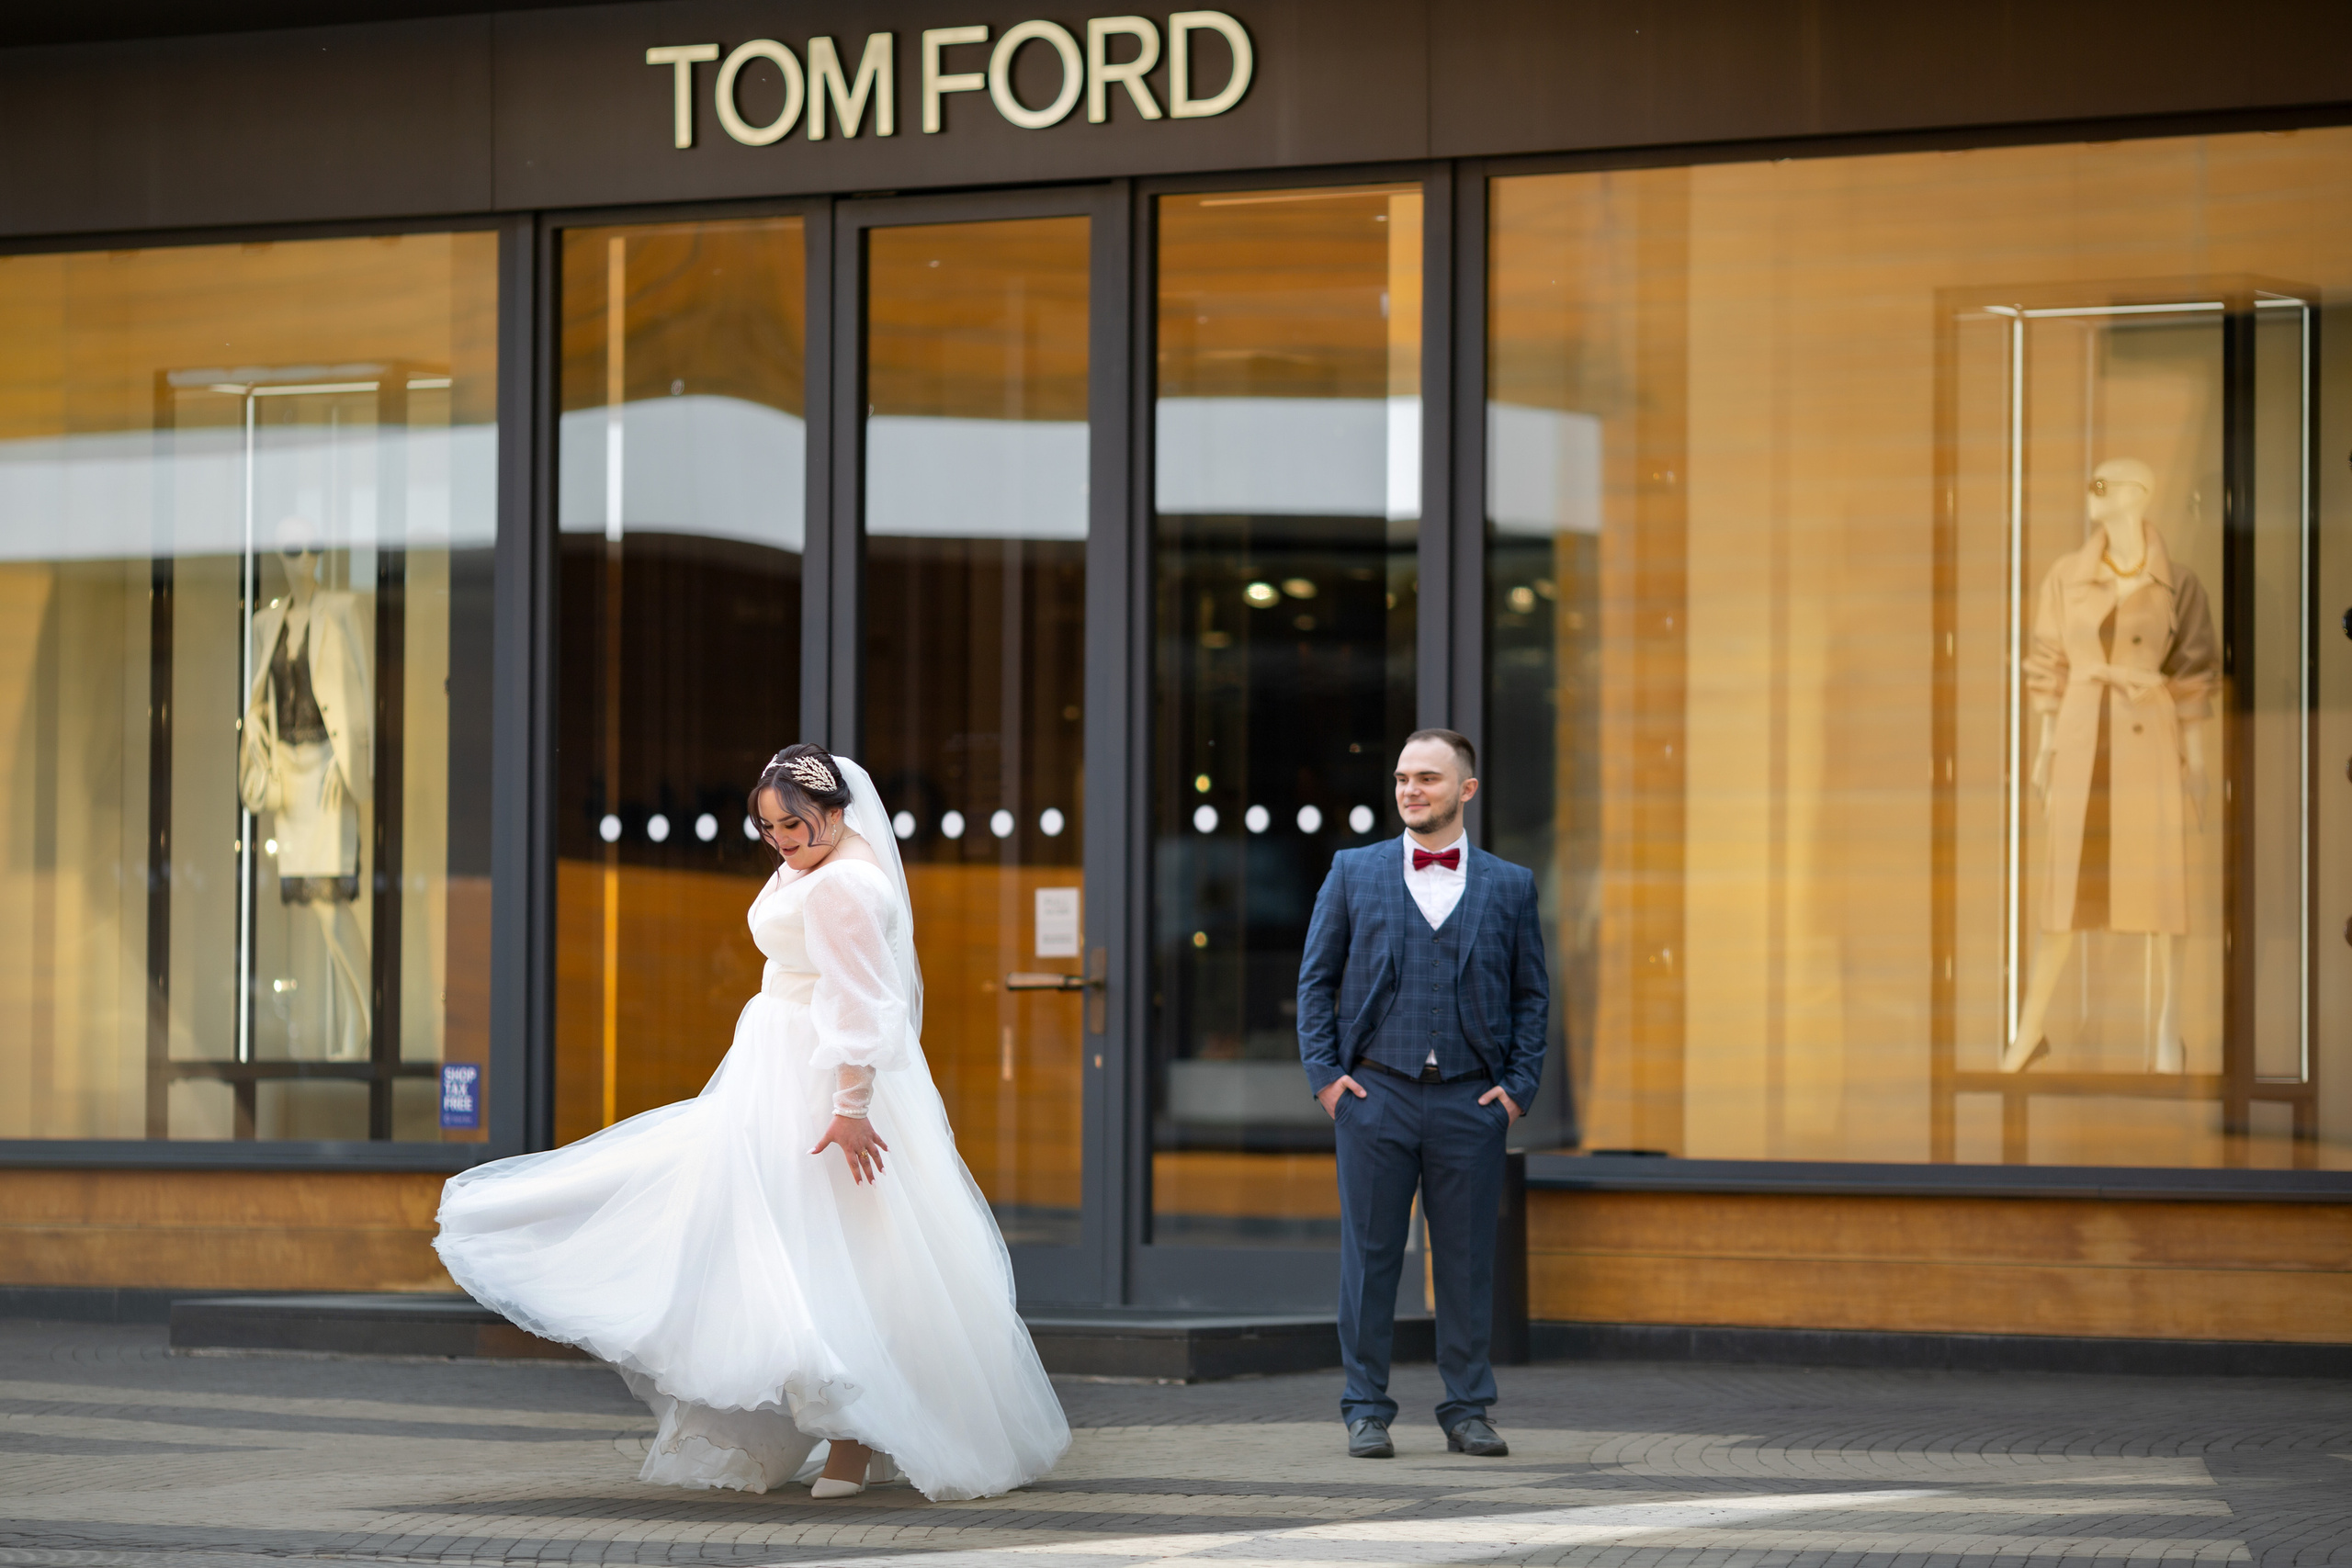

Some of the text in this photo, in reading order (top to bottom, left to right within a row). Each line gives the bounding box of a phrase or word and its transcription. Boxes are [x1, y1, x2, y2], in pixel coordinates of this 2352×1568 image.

[646, 10, 1252, 149] TOM FORD
[444, 1066, 477, 1082] SHOP
[444, 1082, 469, 1096] TAX
[444, 1096, 473, 1111] FREE
